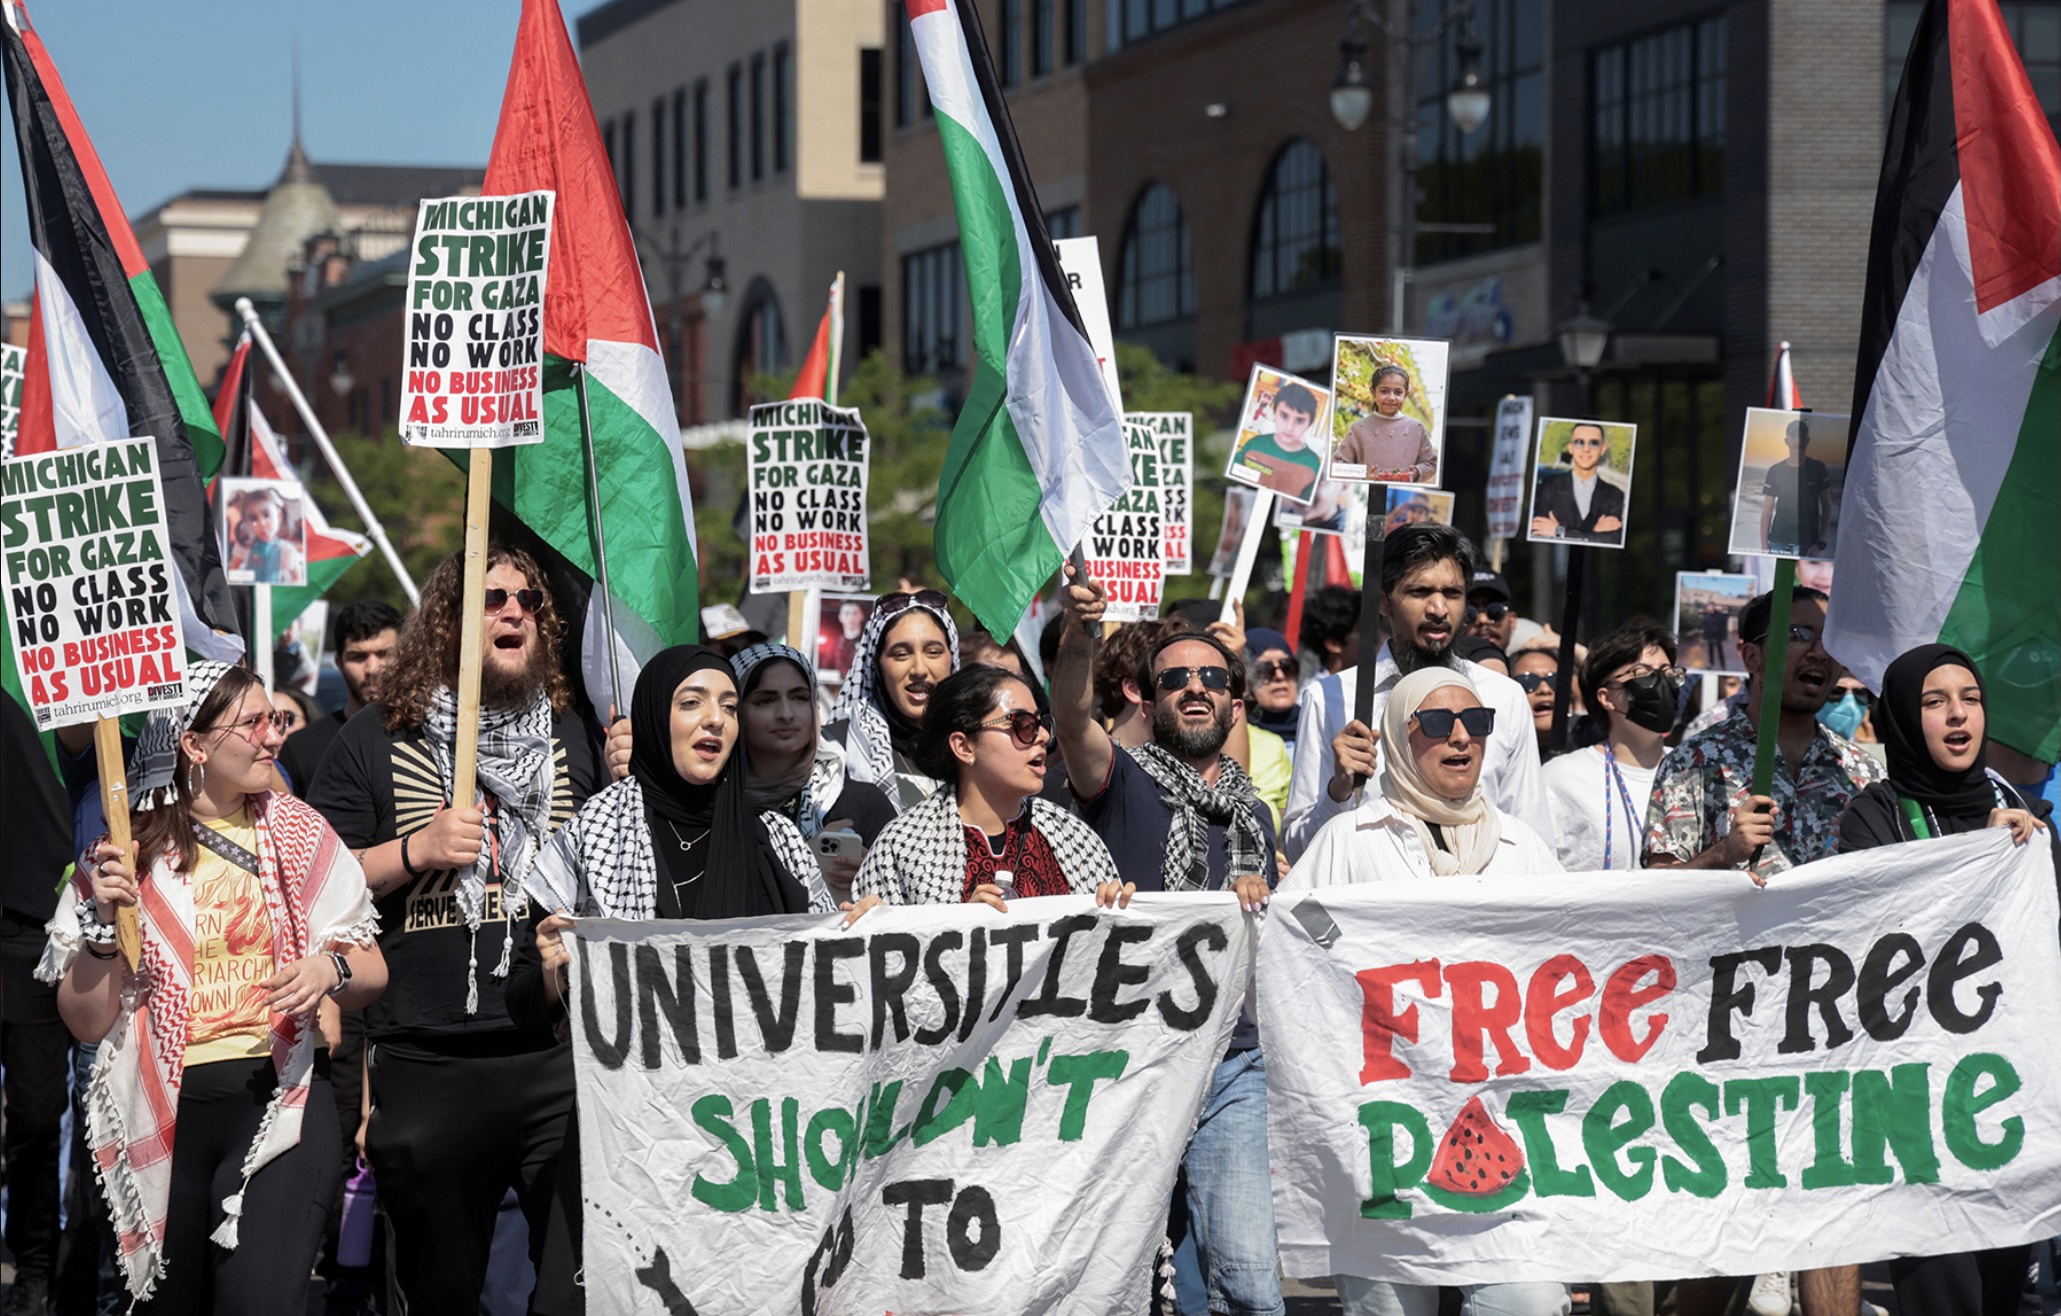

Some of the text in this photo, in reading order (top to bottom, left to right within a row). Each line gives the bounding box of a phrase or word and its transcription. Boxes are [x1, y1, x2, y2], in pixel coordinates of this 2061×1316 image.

[423, 195, 548, 231] MICHIGAN
[415, 229, 546, 277] STRIKE
[413, 275, 540, 311] FOR GAZA
[411, 307, 539, 341] NO CLASS
[410, 336, 538, 368] NO WORK
[408, 366, 537, 394] NO BUSINESS
[407, 391, 538, 425] AS USUAL
[753, 428, 865, 464] STRIKE
[1, 443, 152, 497] MICHIGAN
[754, 464, 862, 489] FOR GAZA
[1, 479, 159, 548] STRIKE
[755, 489, 861, 512] NO CLASS
[755, 510, 861, 533] NO WORK
[1093, 514, 1160, 537] CLASS
[6, 529, 164, 585] FOR GAZA
[755, 532, 863, 552] NO BUSINESS
[1092, 537, 1160, 559] WORK
[756, 550, 864, 576] AS USUAL
[12, 563, 168, 618] NO CLASS
[16, 594, 173, 647] NO WORK
[21, 625, 177, 675] NO BUSINESS
[31, 652, 182, 707] AS USUAL
[575, 915, 1227, 1070] UNIVERSITIES
[882, 1178, 1002, 1281] TO
